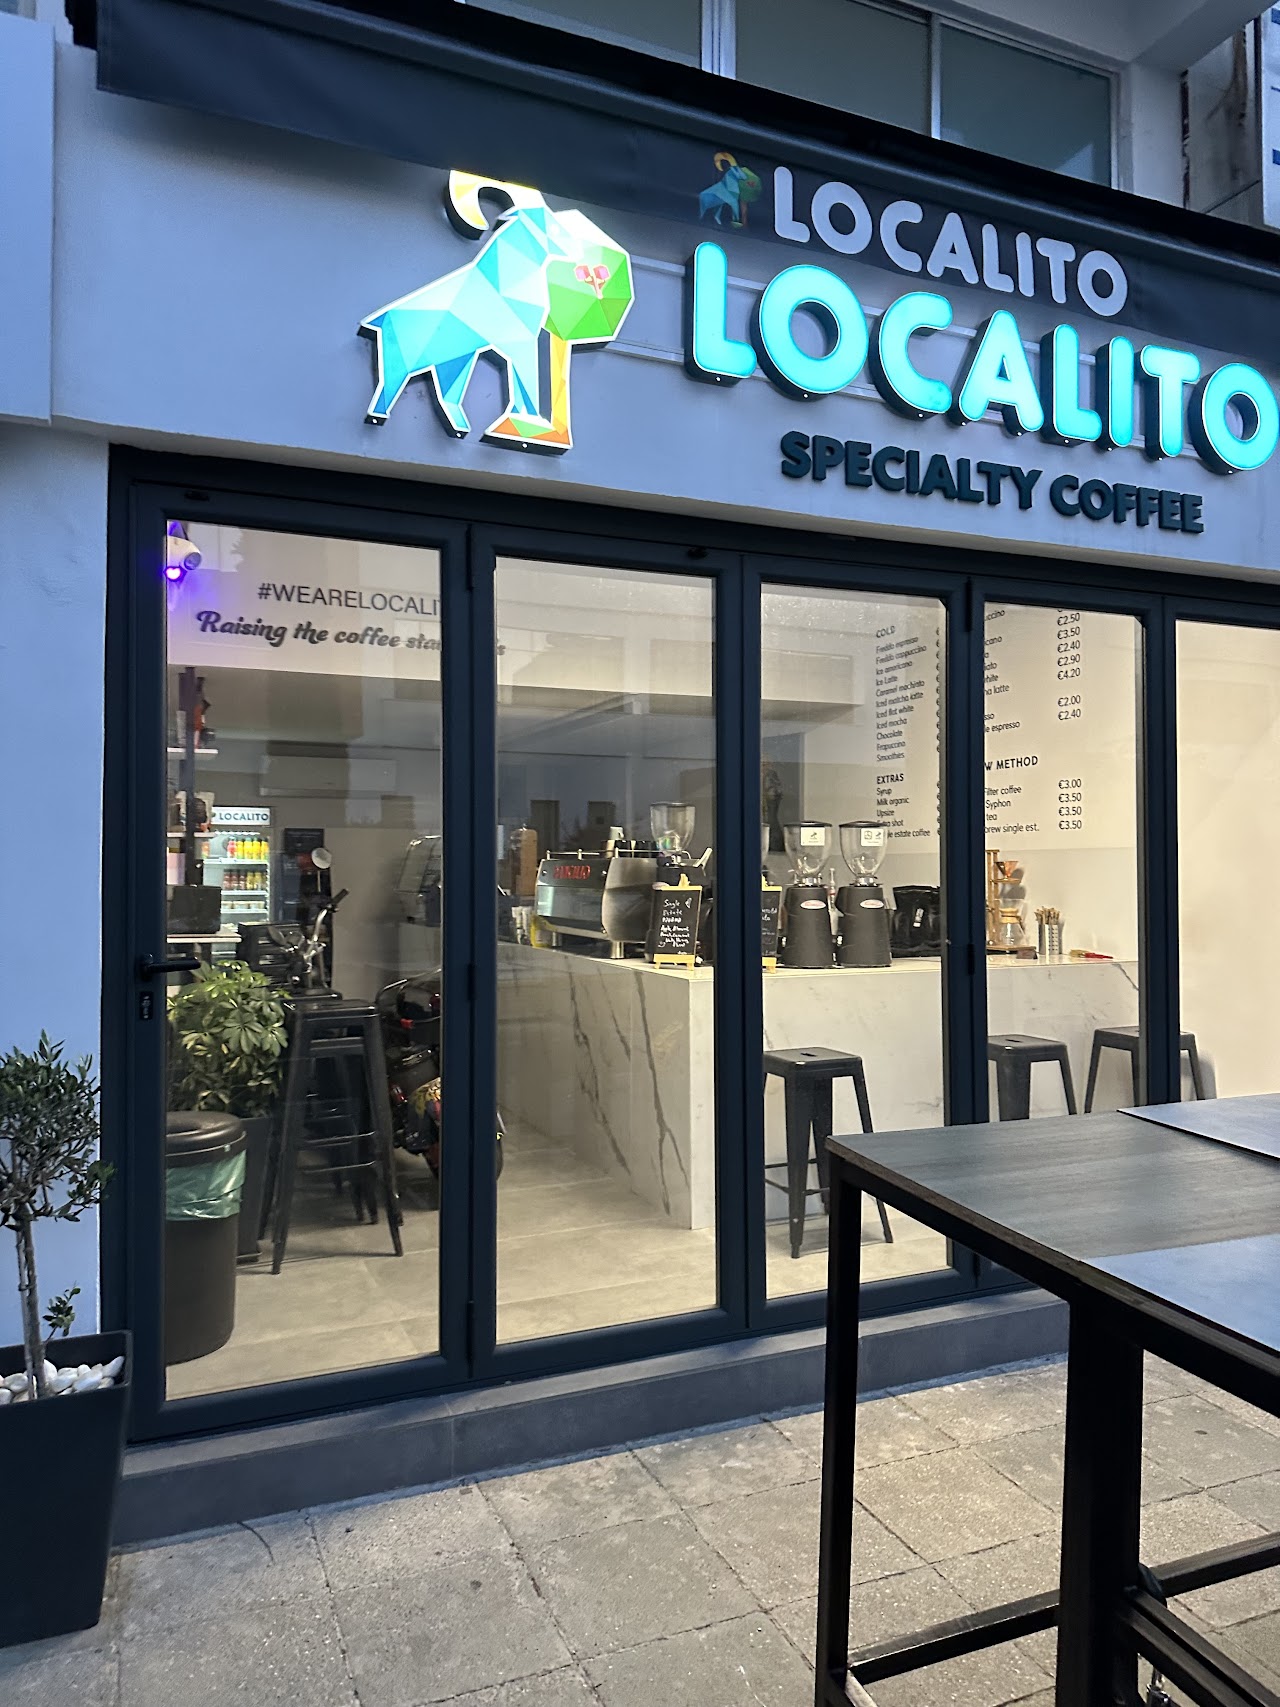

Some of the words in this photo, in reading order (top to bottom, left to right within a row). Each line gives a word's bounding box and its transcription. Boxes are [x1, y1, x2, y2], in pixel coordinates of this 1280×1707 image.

[773, 166, 1128, 317] LOCALITO
[686, 241, 1279, 474] LOCALITO
[780, 430, 1042, 510] SPECIALTY
[1049, 474, 1205, 534] COFFEE
[257, 583, 440, 616] #WEARELOCALI
[1057, 612, 1080, 626] €2.50
[196, 611, 288, 648] Raising
[293, 622, 329, 645] the
[334, 627, 401, 649] coffee
[876, 626, 895, 638] COLD
[1057, 626, 1080, 640] €3.50
[1057, 640, 1081, 653] €2.40
[1057, 653, 1081, 667] €2.90
[1057, 667, 1081, 680] €4.20
[993, 684, 1010, 694] latte
[1057, 694, 1081, 707] €2.00
[1058, 708, 1081, 721] €2.40
[992, 721, 1021, 732] espresso
[996, 756, 1038, 770] METHOD
[877, 773, 904, 784] EXTRAS
[1058, 778, 1082, 789] €3.00
[877, 788, 892, 796] Syrup
[1000, 785, 1022, 795] coffee
[889, 797, 910, 806] organic
[1058, 792, 1082, 803] €3.50
[985, 799, 1011, 810] Syphon
[219, 812, 269, 821] LOCALITO
[1058, 806, 1082, 816] €3.50
[892, 818, 904, 827] shot
[986, 813, 998, 821] tea
[1002, 823, 1024, 834] single
[1025, 823, 1040, 832] est.
[1058, 820, 1082, 830] €3.50
